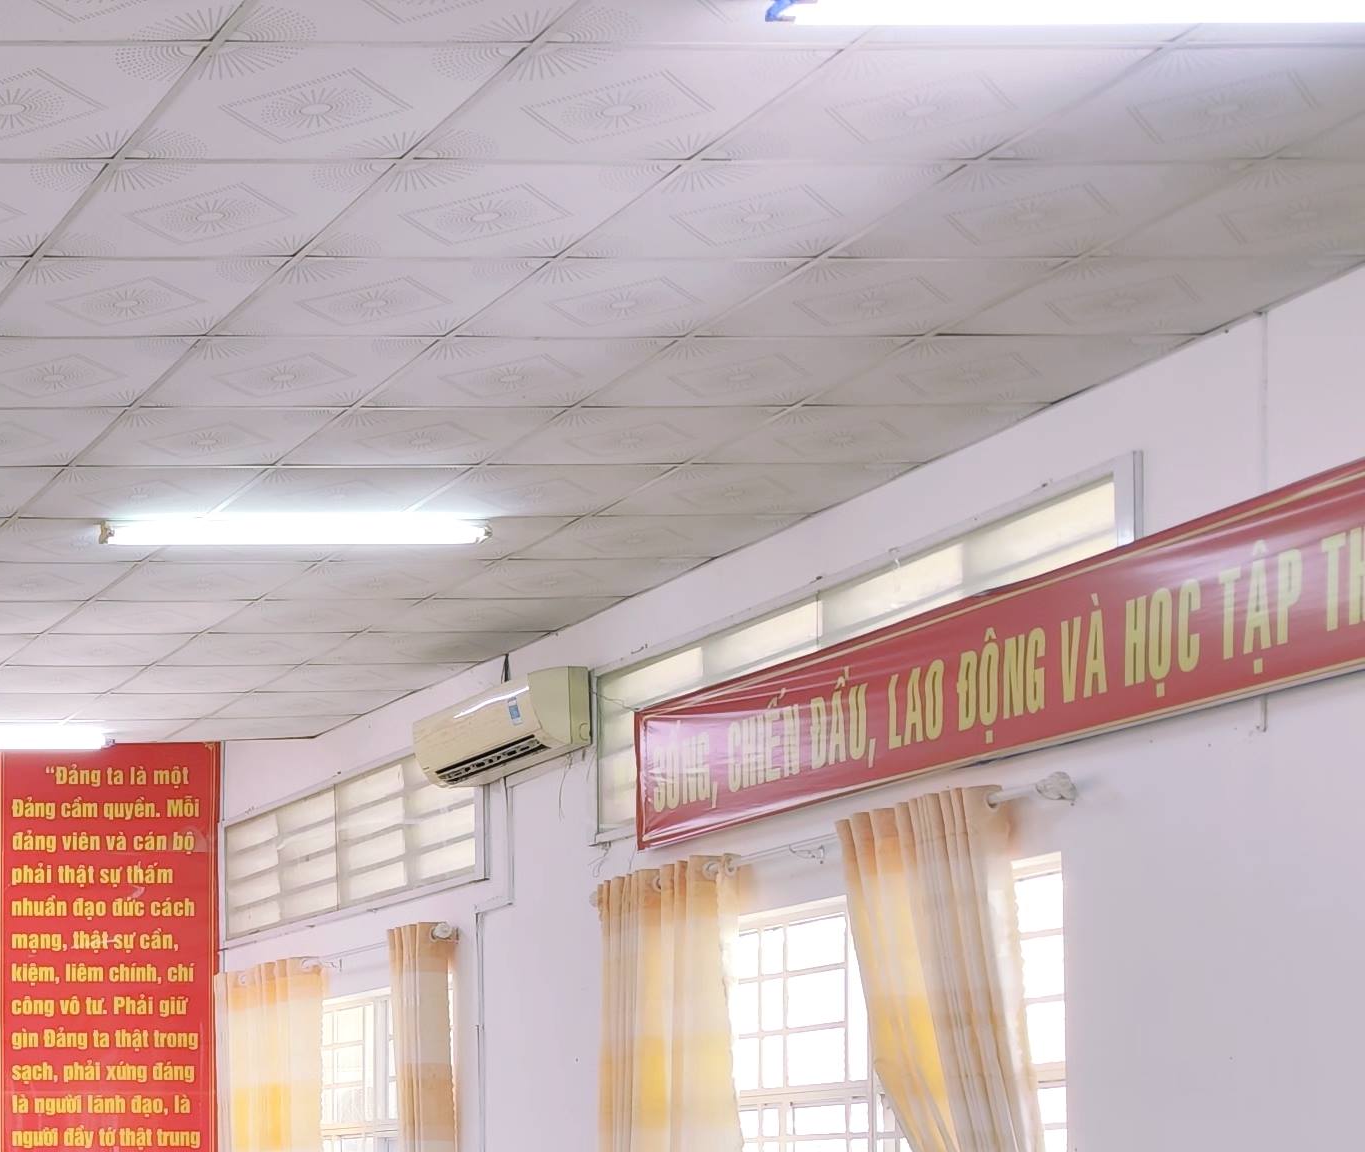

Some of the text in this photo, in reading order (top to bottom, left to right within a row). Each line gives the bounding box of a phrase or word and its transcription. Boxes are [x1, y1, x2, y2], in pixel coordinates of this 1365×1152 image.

[728, 688, 800, 792] CHIẾN
[810, 666, 876, 769] ĐẤU,
[887, 659, 945, 750] LAO
[957, 627, 1046, 743] ĐỘNG
[1060, 593, 1108, 702] VÀ
[1124, 580, 1200, 698] HỌC
[1219, 539, 1302, 674] TẬP
[107, 767, 123, 785] ta
[130, 766, 146, 785] là
[153, 766, 189, 789] một
[12, 795, 200, 820] Đảng cầm quyền. Mỗi
[12, 830, 195, 855] đảng viên và cán bộ
[11, 862, 173, 887] phải thật sự thấm
[73, 897, 106, 920] đạo
[112, 897, 145, 916] đức
[150, 897, 195, 917] cách
[11, 963, 195, 986] kiệm, liêm chính, chí
[11, 994, 189, 1017] công vô tư. Phải giữ
[12, 1027, 199, 1052] gìn Đảng ta thật trong
[12, 1059, 195, 1084] sạch, phải xứng đáng
